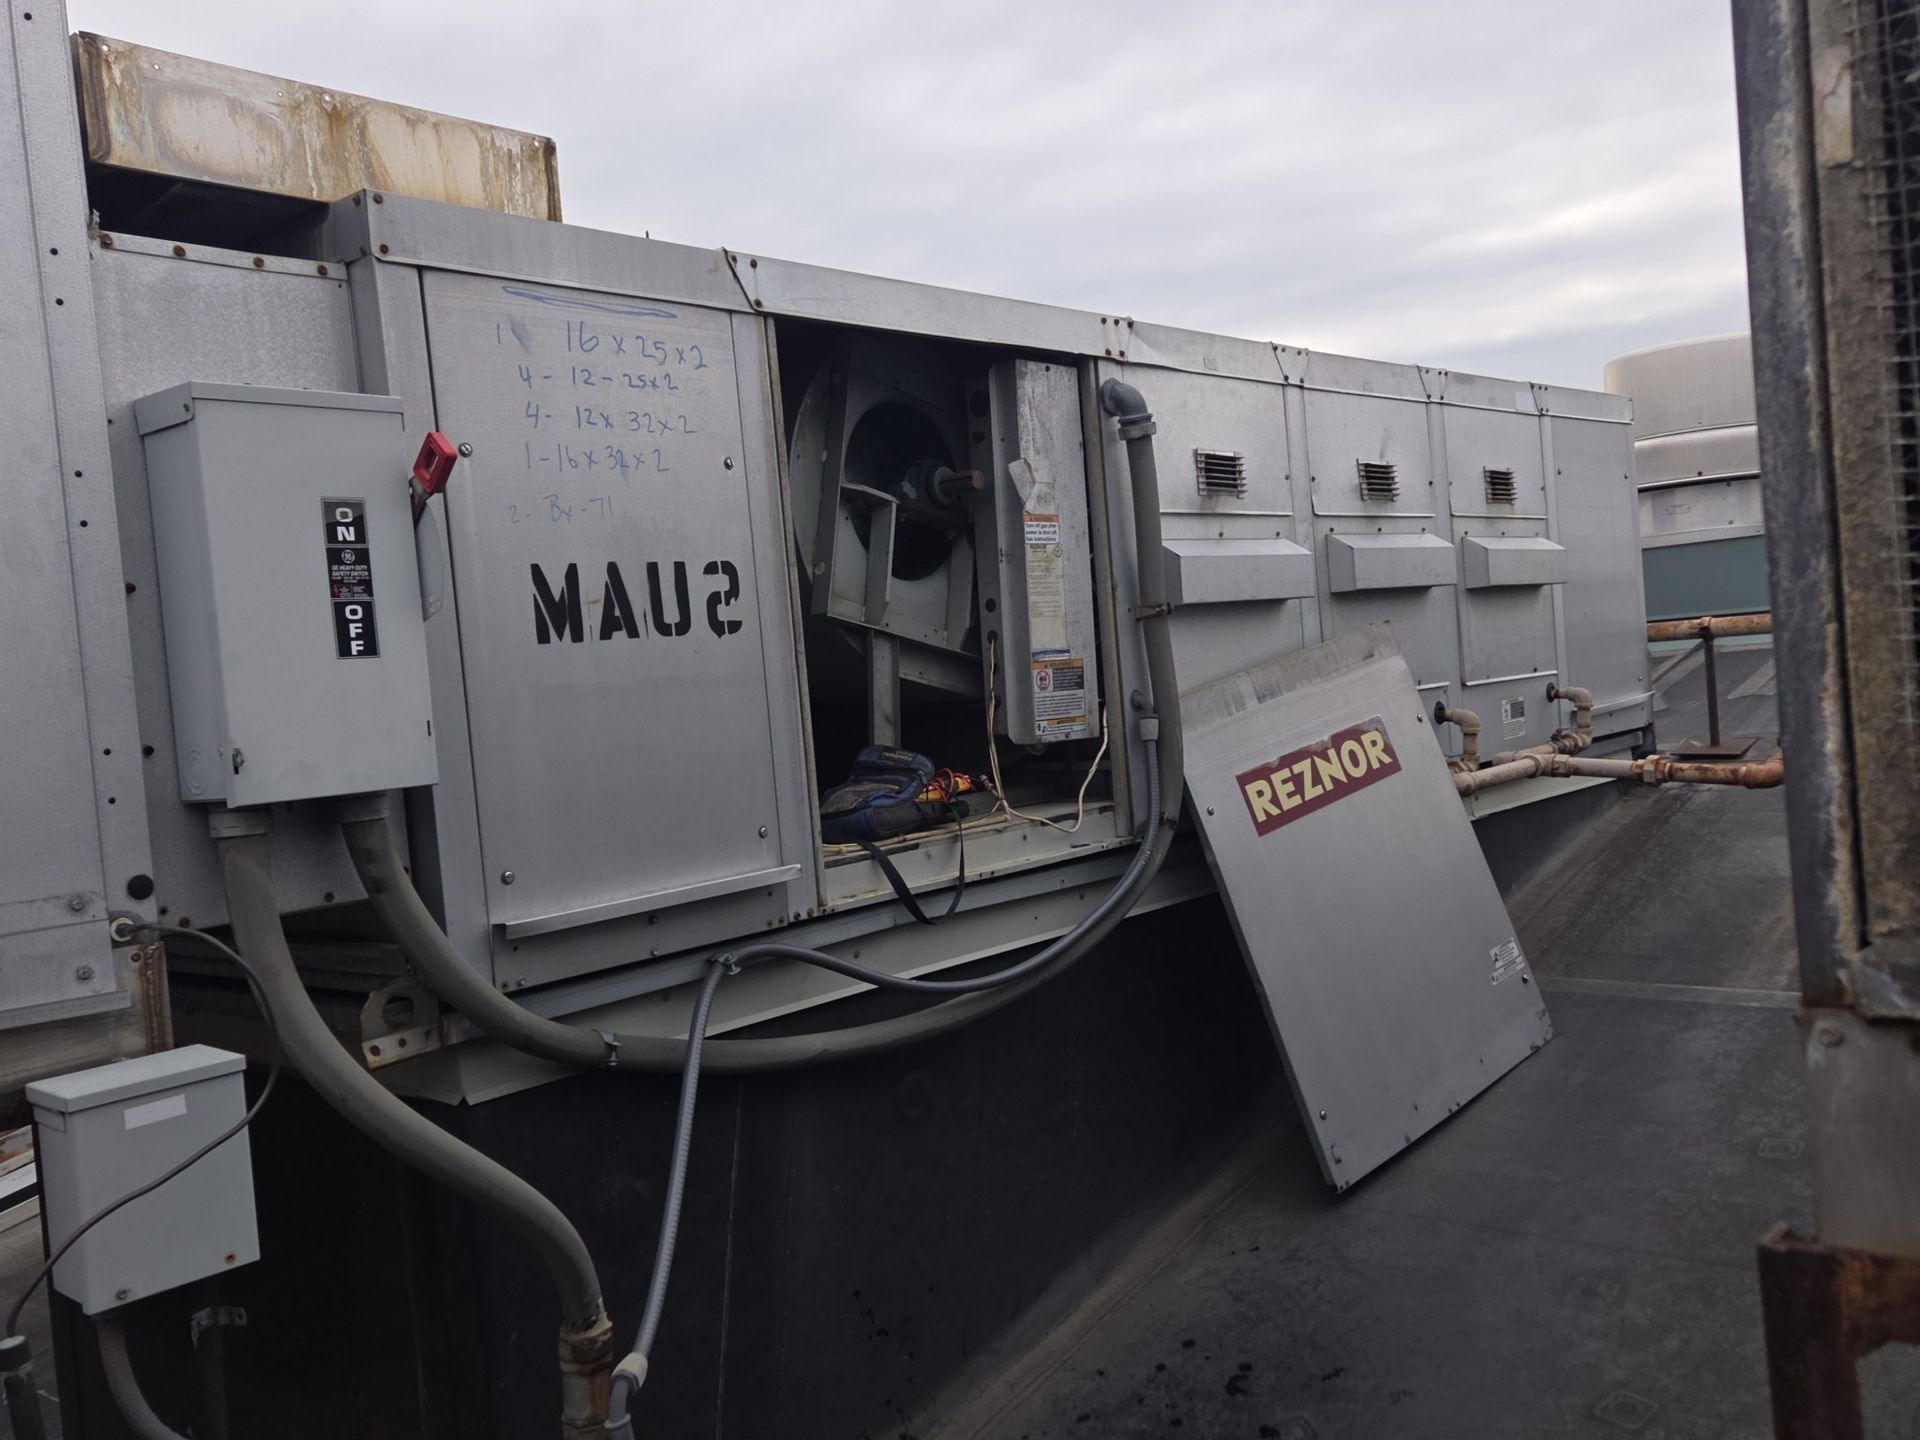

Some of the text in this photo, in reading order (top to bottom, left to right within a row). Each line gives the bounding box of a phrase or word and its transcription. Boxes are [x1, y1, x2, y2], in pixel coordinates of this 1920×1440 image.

[335, 507, 356, 541] ON
[345, 604, 364, 655] OFF
[1244, 730, 1393, 823] REZNOR
